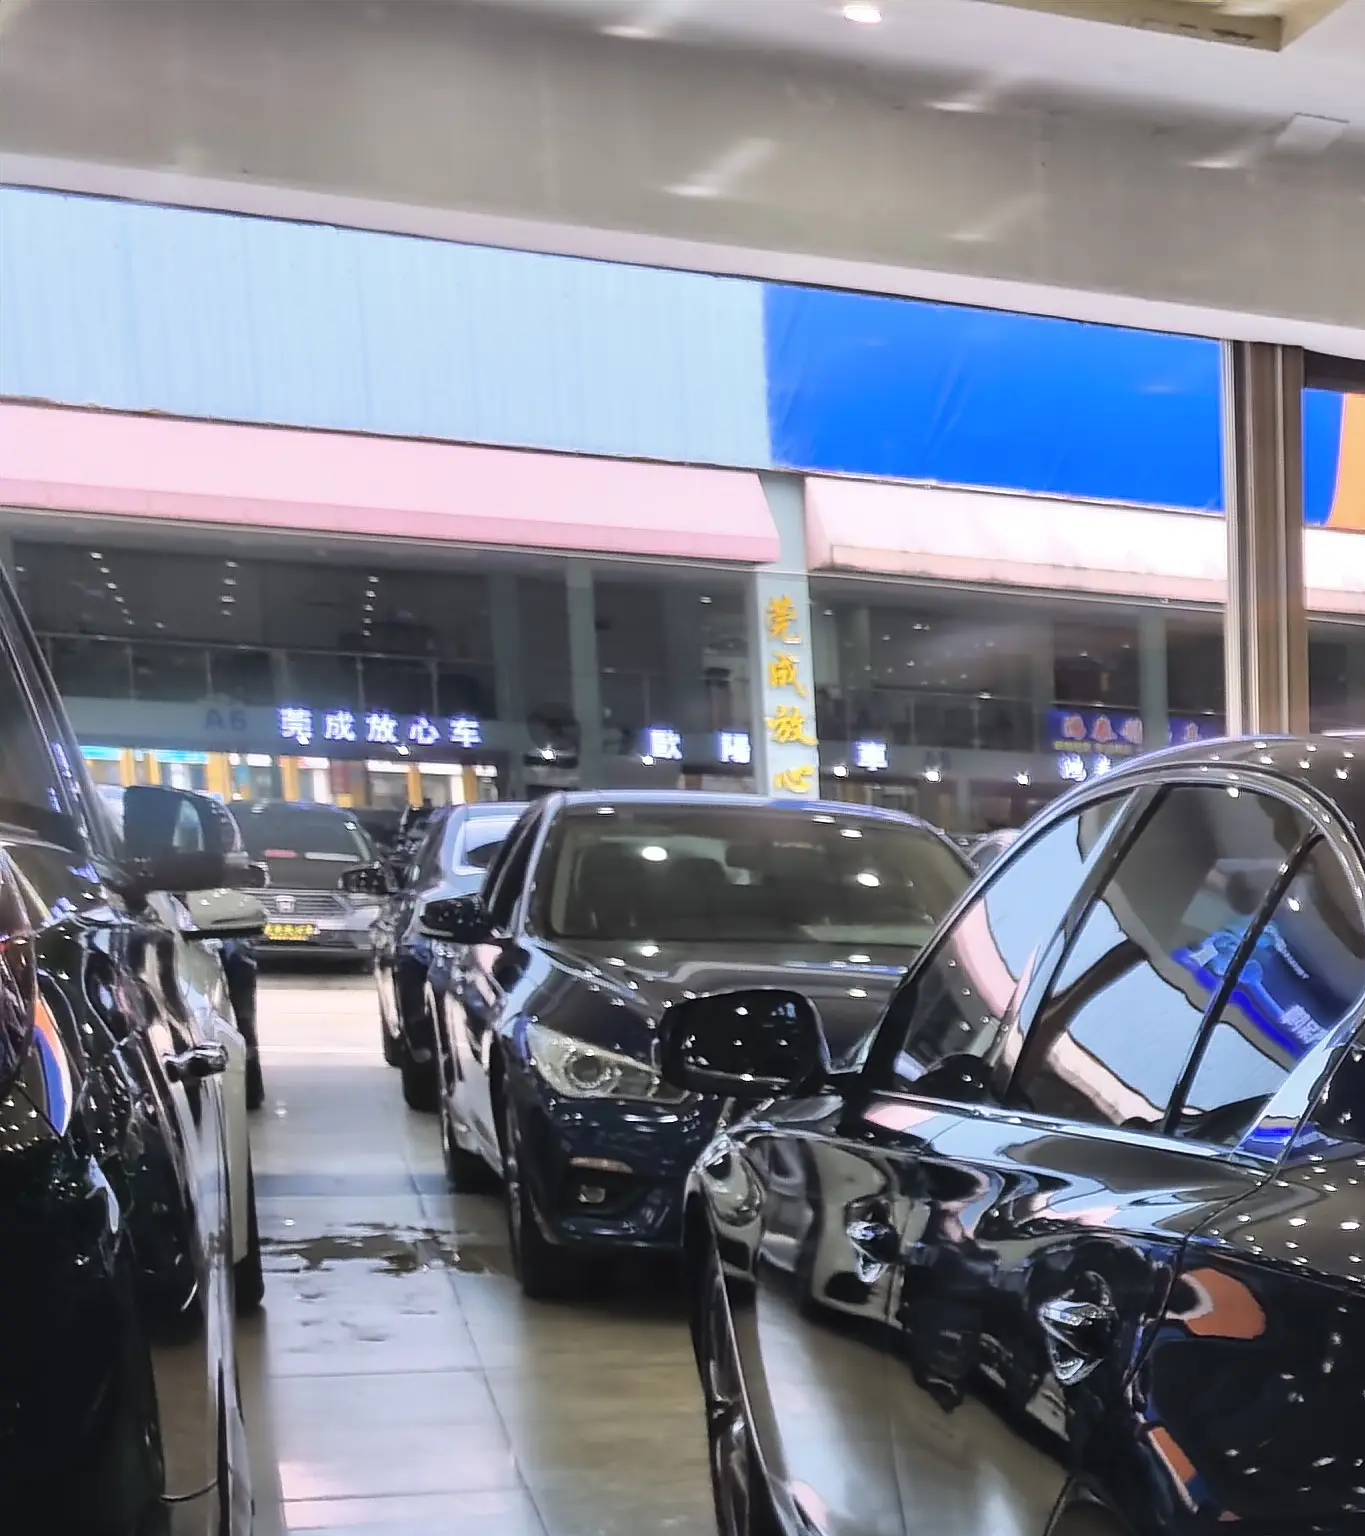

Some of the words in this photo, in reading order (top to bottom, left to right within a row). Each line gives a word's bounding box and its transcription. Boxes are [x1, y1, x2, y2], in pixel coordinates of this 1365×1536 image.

[279, 706, 482, 748] 莞成放心车
